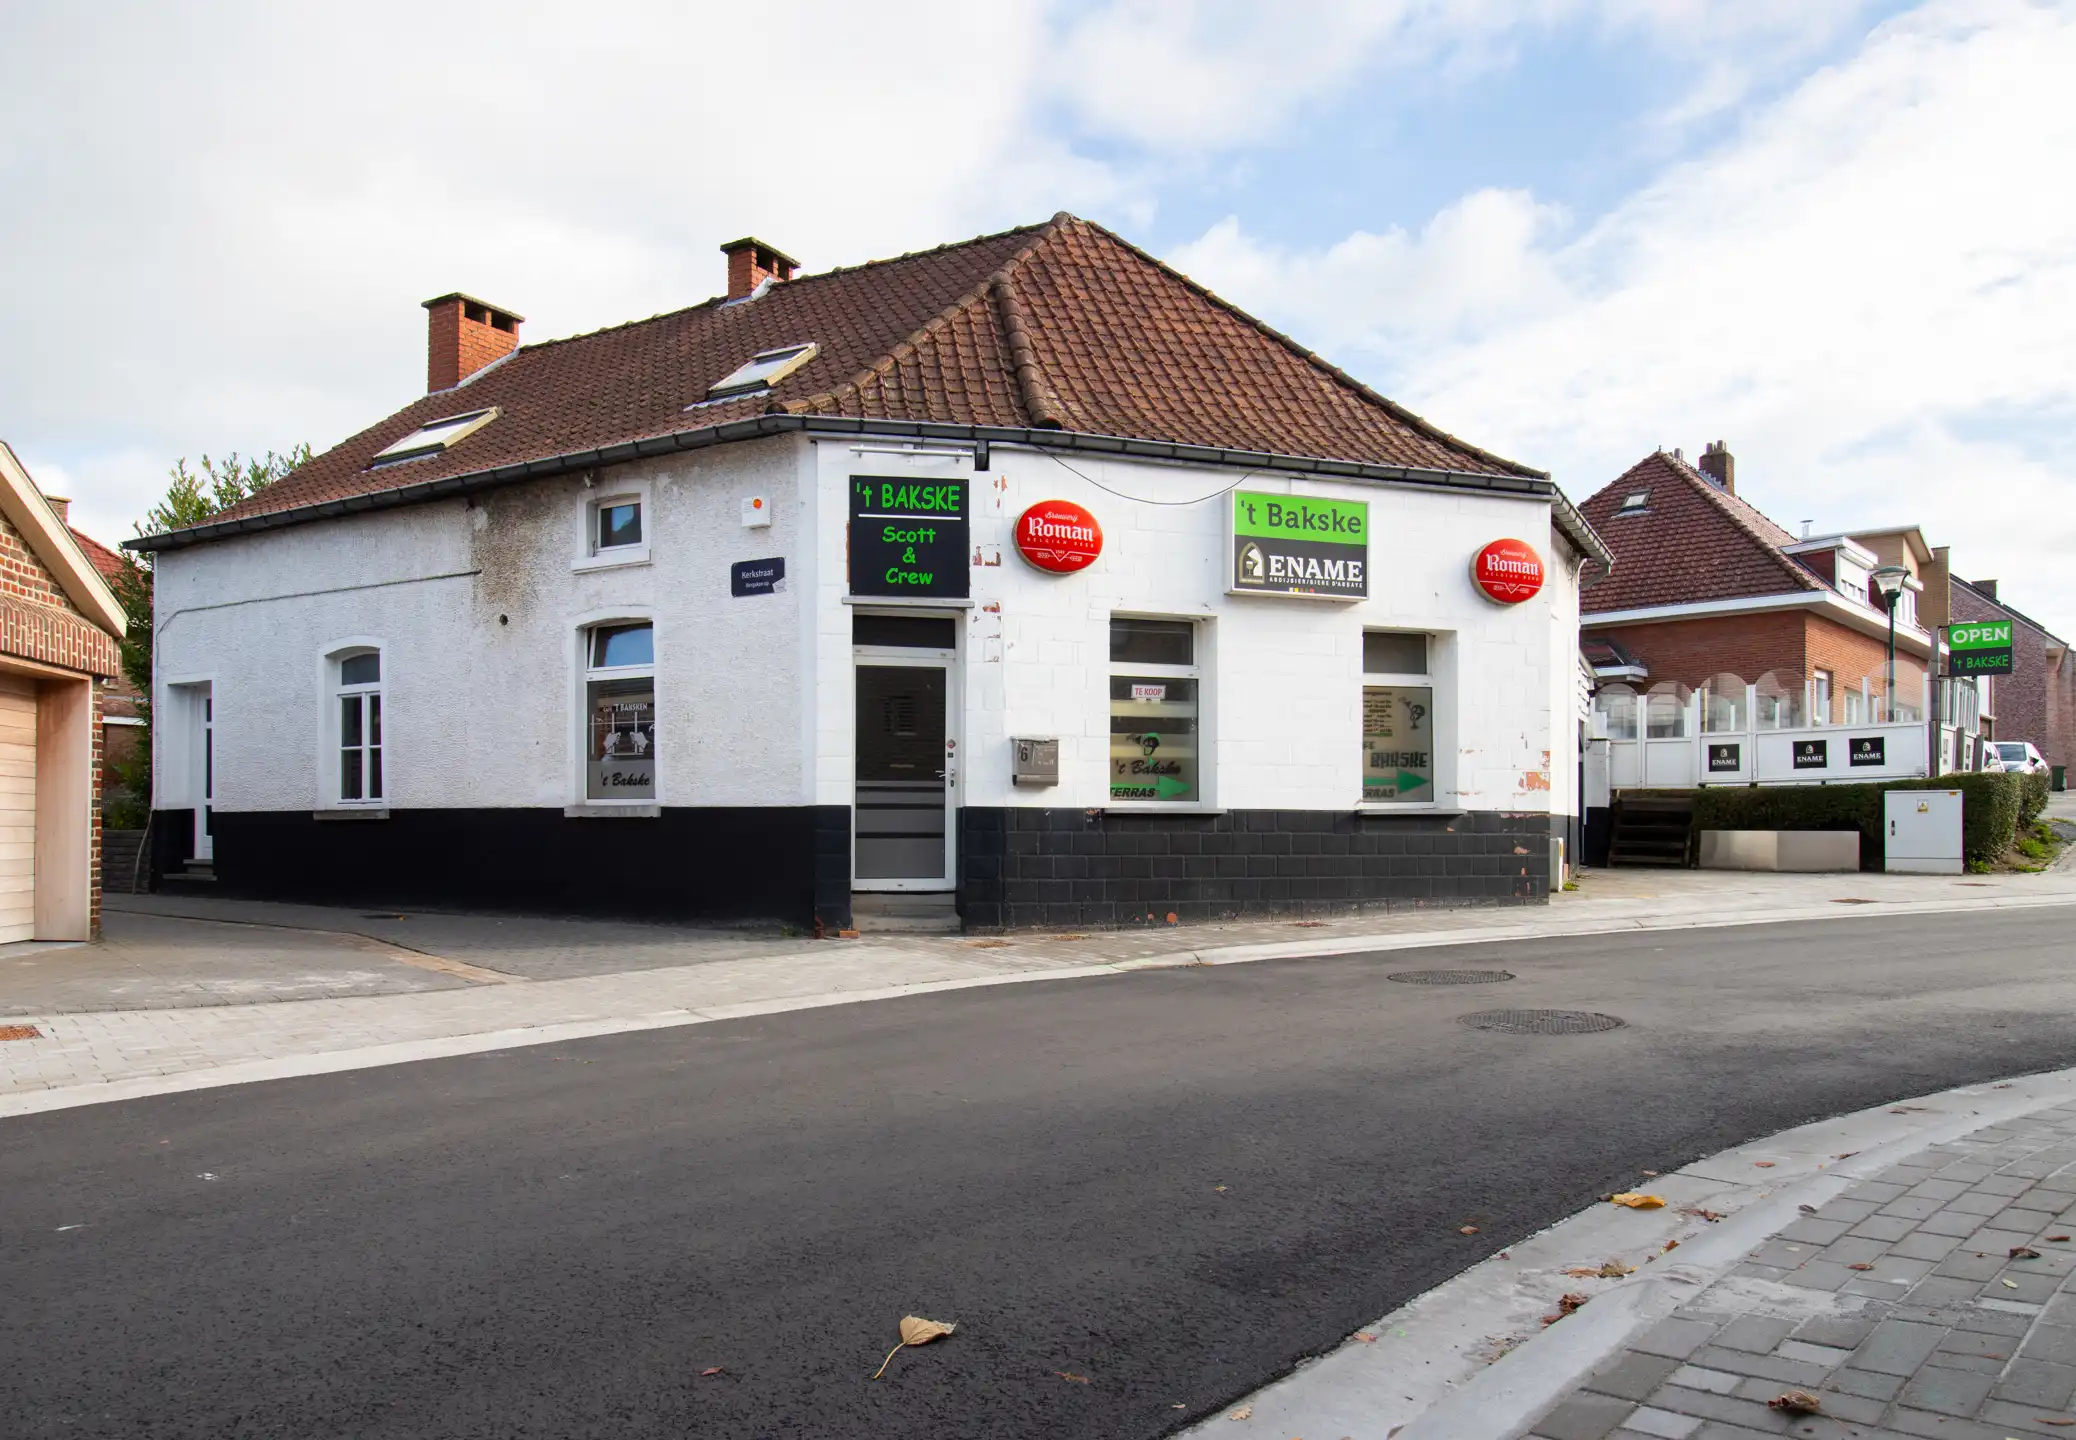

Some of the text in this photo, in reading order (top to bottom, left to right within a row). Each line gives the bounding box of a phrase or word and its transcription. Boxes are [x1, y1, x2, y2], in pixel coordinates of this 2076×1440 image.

[856, 482, 961, 511] 't BAKSKE
[1240, 499, 1362, 534] 't Bakske
[882, 526, 937, 544] Scott
[1027, 516, 1094, 542] Roman
[902, 546, 916, 564] &
[1268, 554, 1363, 582] ENAME
[1485, 553, 1540, 576] Roman
[741, 568, 774, 580] Kerkstraat
[885, 567, 933, 585] Crew
[1952, 626, 2009, 644] OPEN
[1966, 654, 2009, 669] BAKSKE
[1135, 687, 1163, 696] TE KOOP
[1020, 746, 1029, 762] 6
[1370, 751, 1428, 769] BAKSKE
[1711, 758, 1737, 766] ENAME
[1796, 755, 1824, 763] ENAME
[1853, 752, 1882, 761] ENAME
[601, 771, 651, 787] 't Bakske
